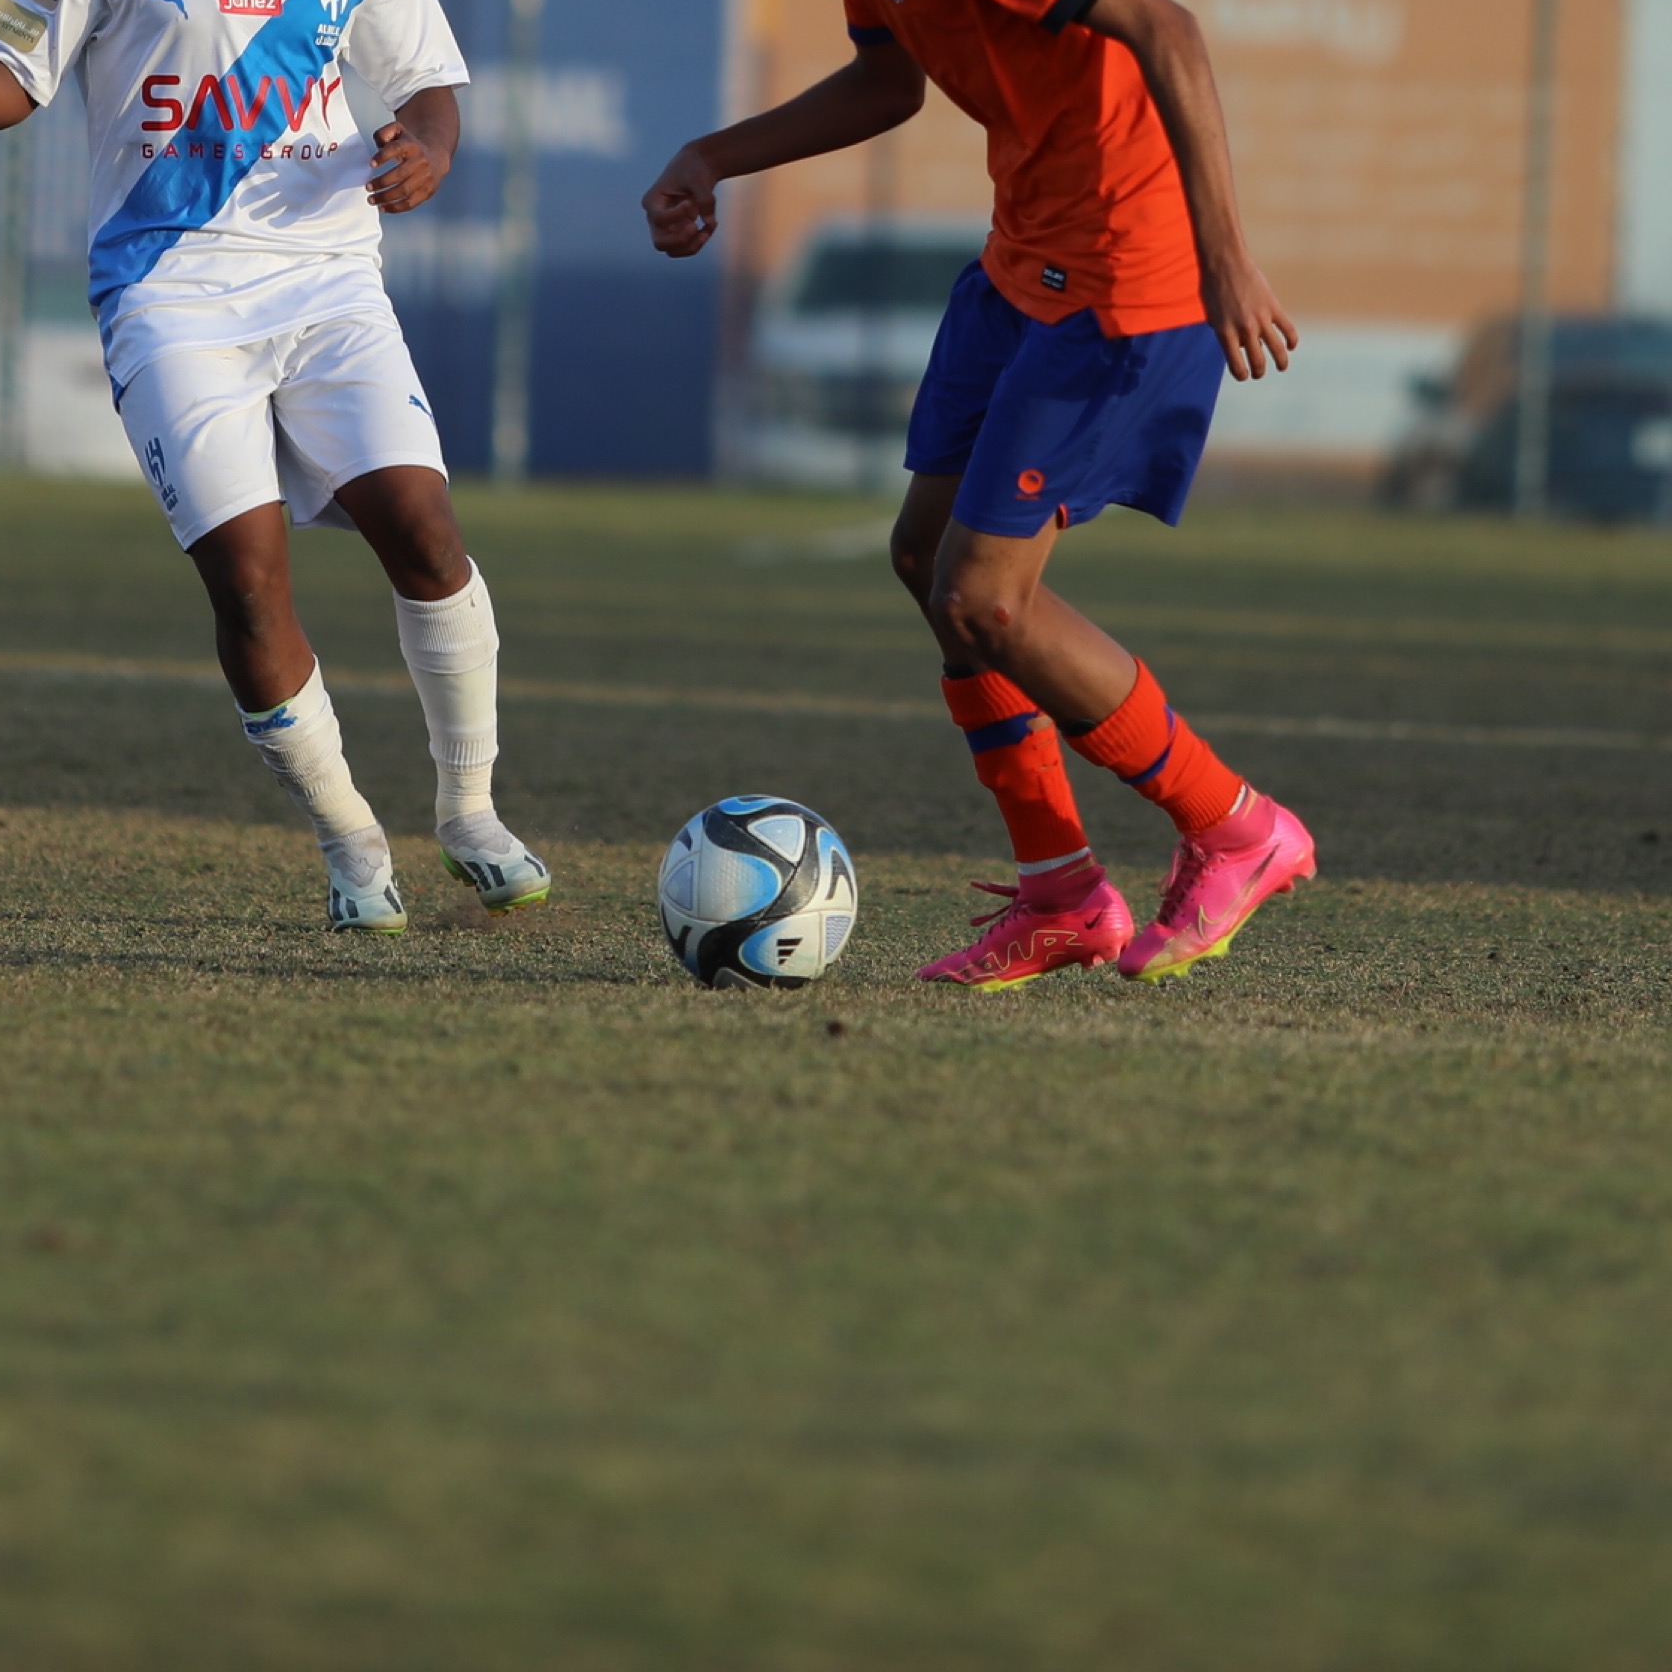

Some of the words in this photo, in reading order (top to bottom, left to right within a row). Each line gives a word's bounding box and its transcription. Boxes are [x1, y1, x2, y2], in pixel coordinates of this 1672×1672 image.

[141, 74, 341, 132] SAVVY
[142, 143, 244, 160] GAMES
[260, 142, 338, 160] GROUP
